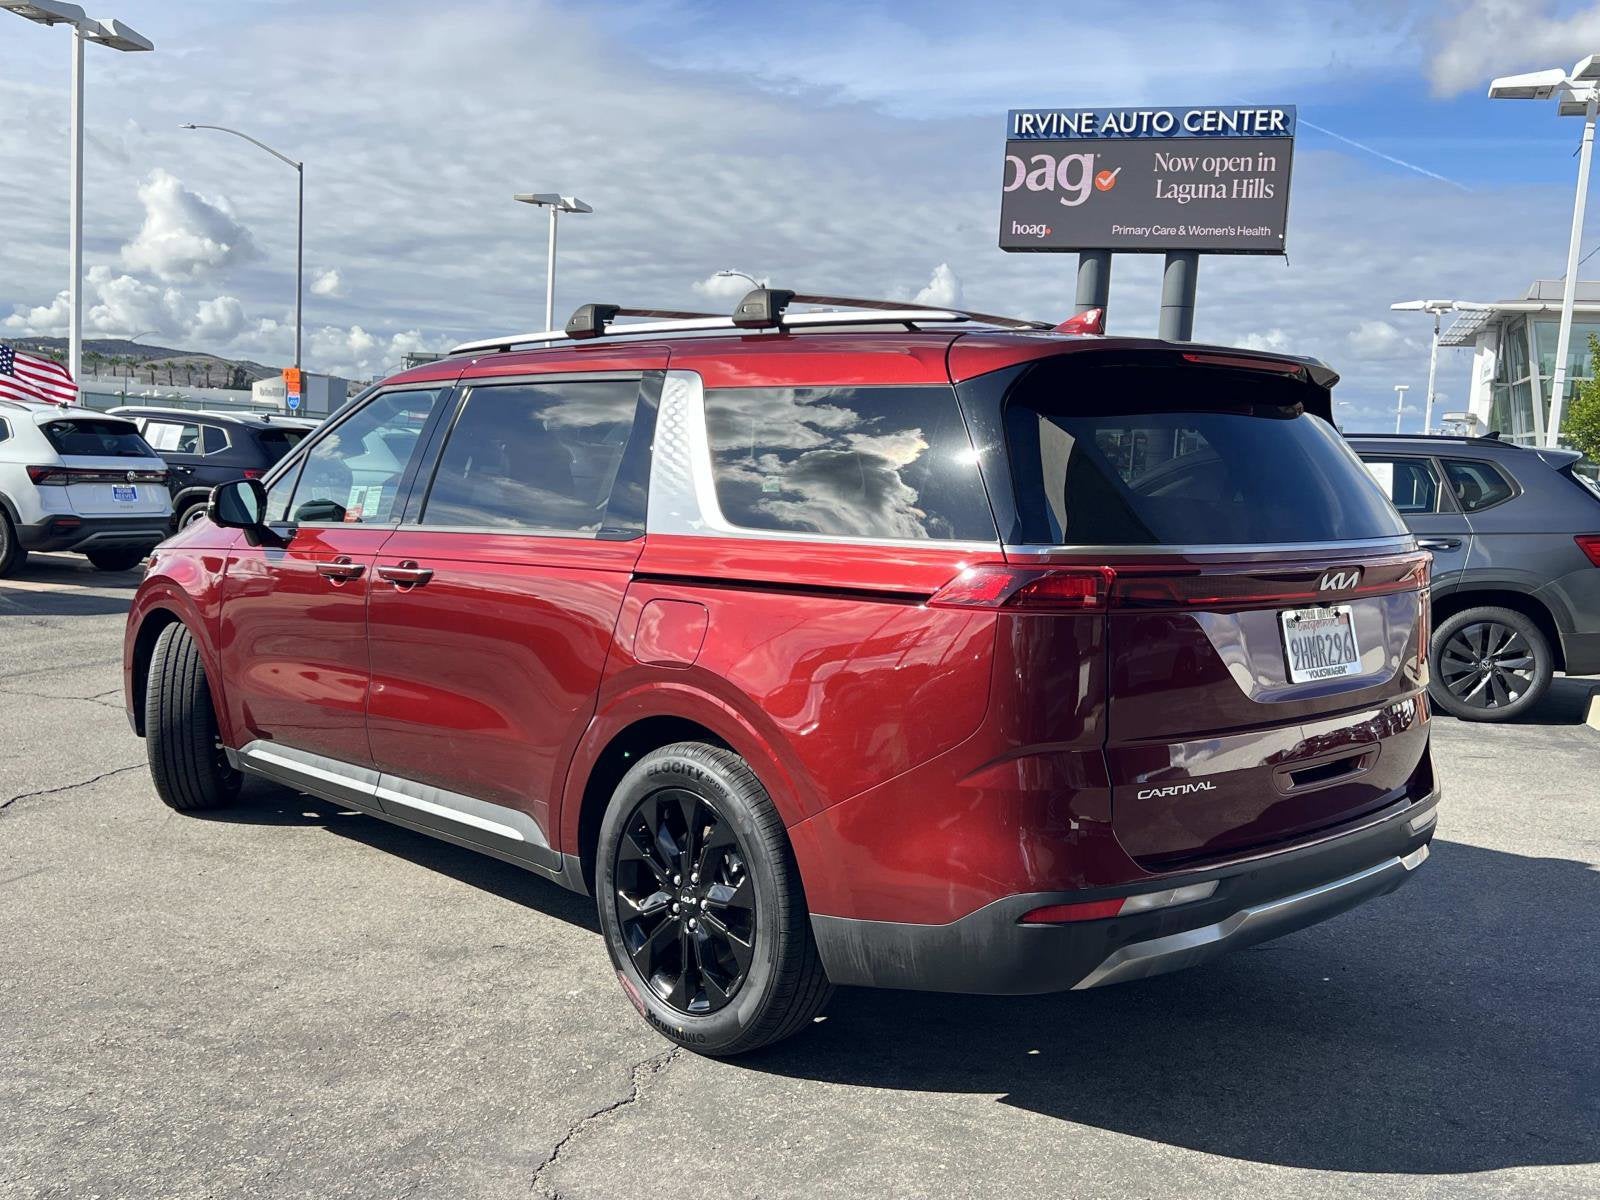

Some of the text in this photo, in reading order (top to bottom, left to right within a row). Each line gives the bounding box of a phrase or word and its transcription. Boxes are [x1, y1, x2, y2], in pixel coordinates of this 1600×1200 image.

[1014, 109, 1285, 135] IRVINE AUTO CENTER
[1153, 151, 1276, 178] Now open in
[1155, 178, 1274, 204] Laguna Hills
[1111, 224, 1271, 238] Primary Care & Women's Health
[1291, 631, 1352, 672] 9HMR296
[1137, 780, 1217, 800] CARNIVAL
